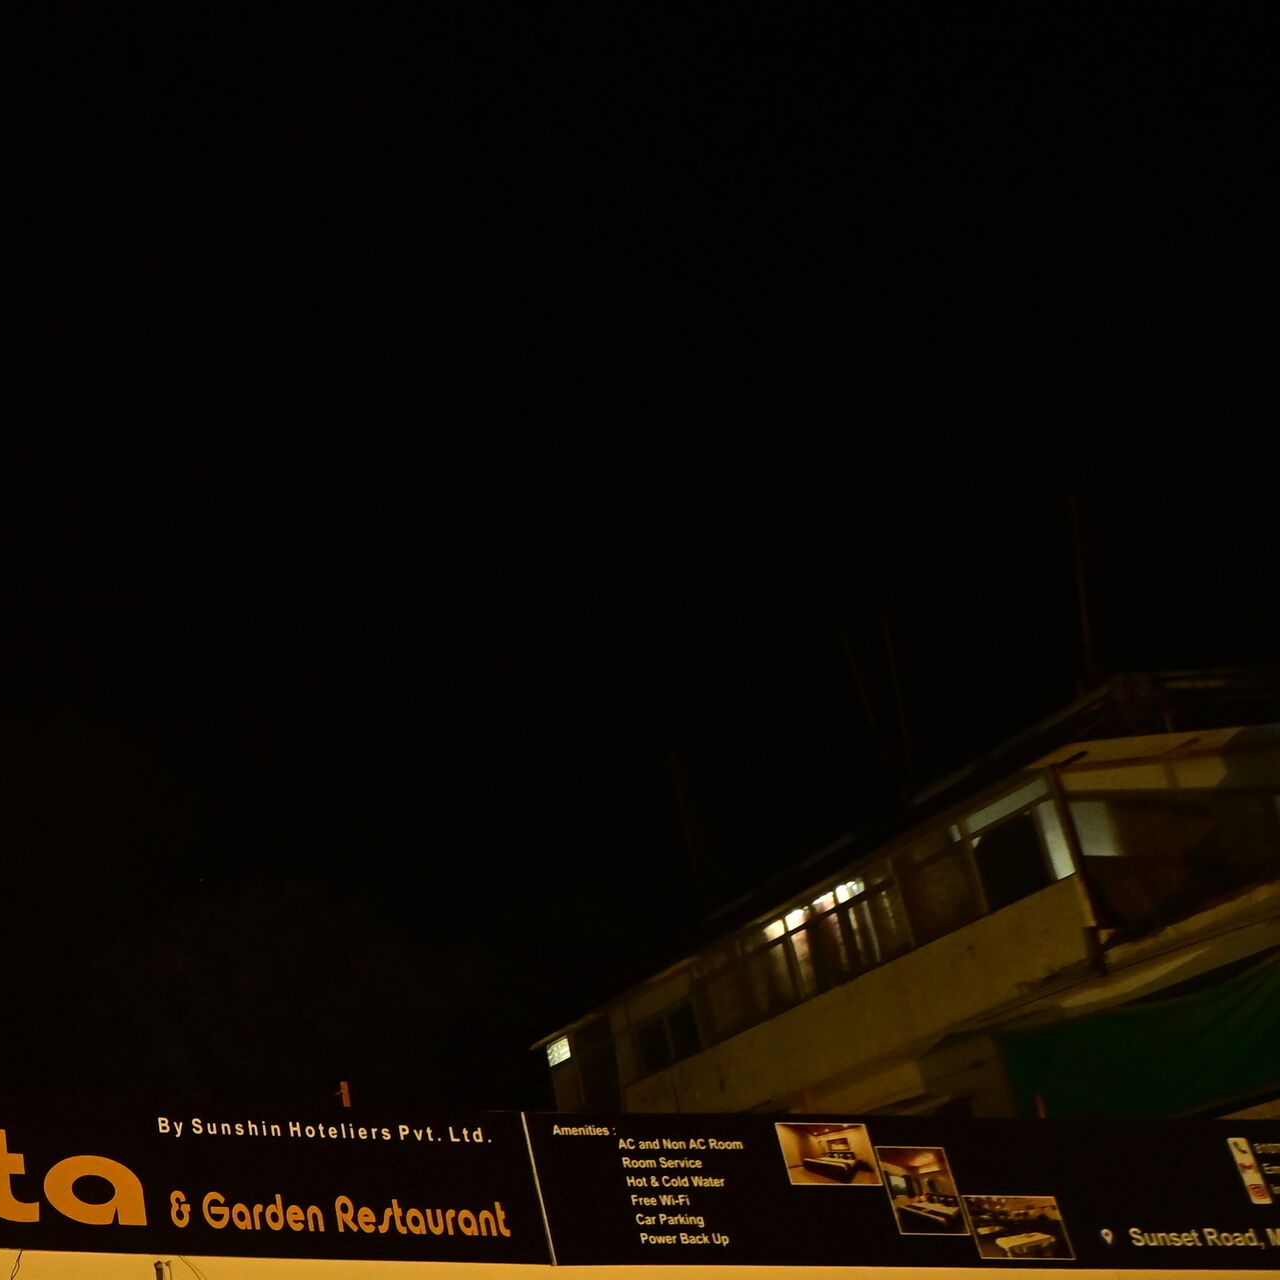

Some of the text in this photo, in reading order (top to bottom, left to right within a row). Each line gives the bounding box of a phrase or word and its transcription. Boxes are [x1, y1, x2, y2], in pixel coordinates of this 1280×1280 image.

[158, 1117, 492, 1143] By Sunshin Hoteliers Pvt. Ltd.
[553, 1125, 609, 1135] Amenities
[618, 1139, 743, 1150] AC and Non AC Room
[622, 1157, 702, 1168] Room Service
[626, 1176, 725, 1187] Hot & Cold Water
[631, 1195, 690, 1205] Free Wi-Fi
[170, 1190, 511, 1237] & Garden Restaurant
[636, 1214, 704, 1228] Car Parking
[640, 1233, 729, 1246] Power Back Up
[1128, 1227, 1202, 1246] Sunset
[1203, 1228, 1265, 1249] Road,
